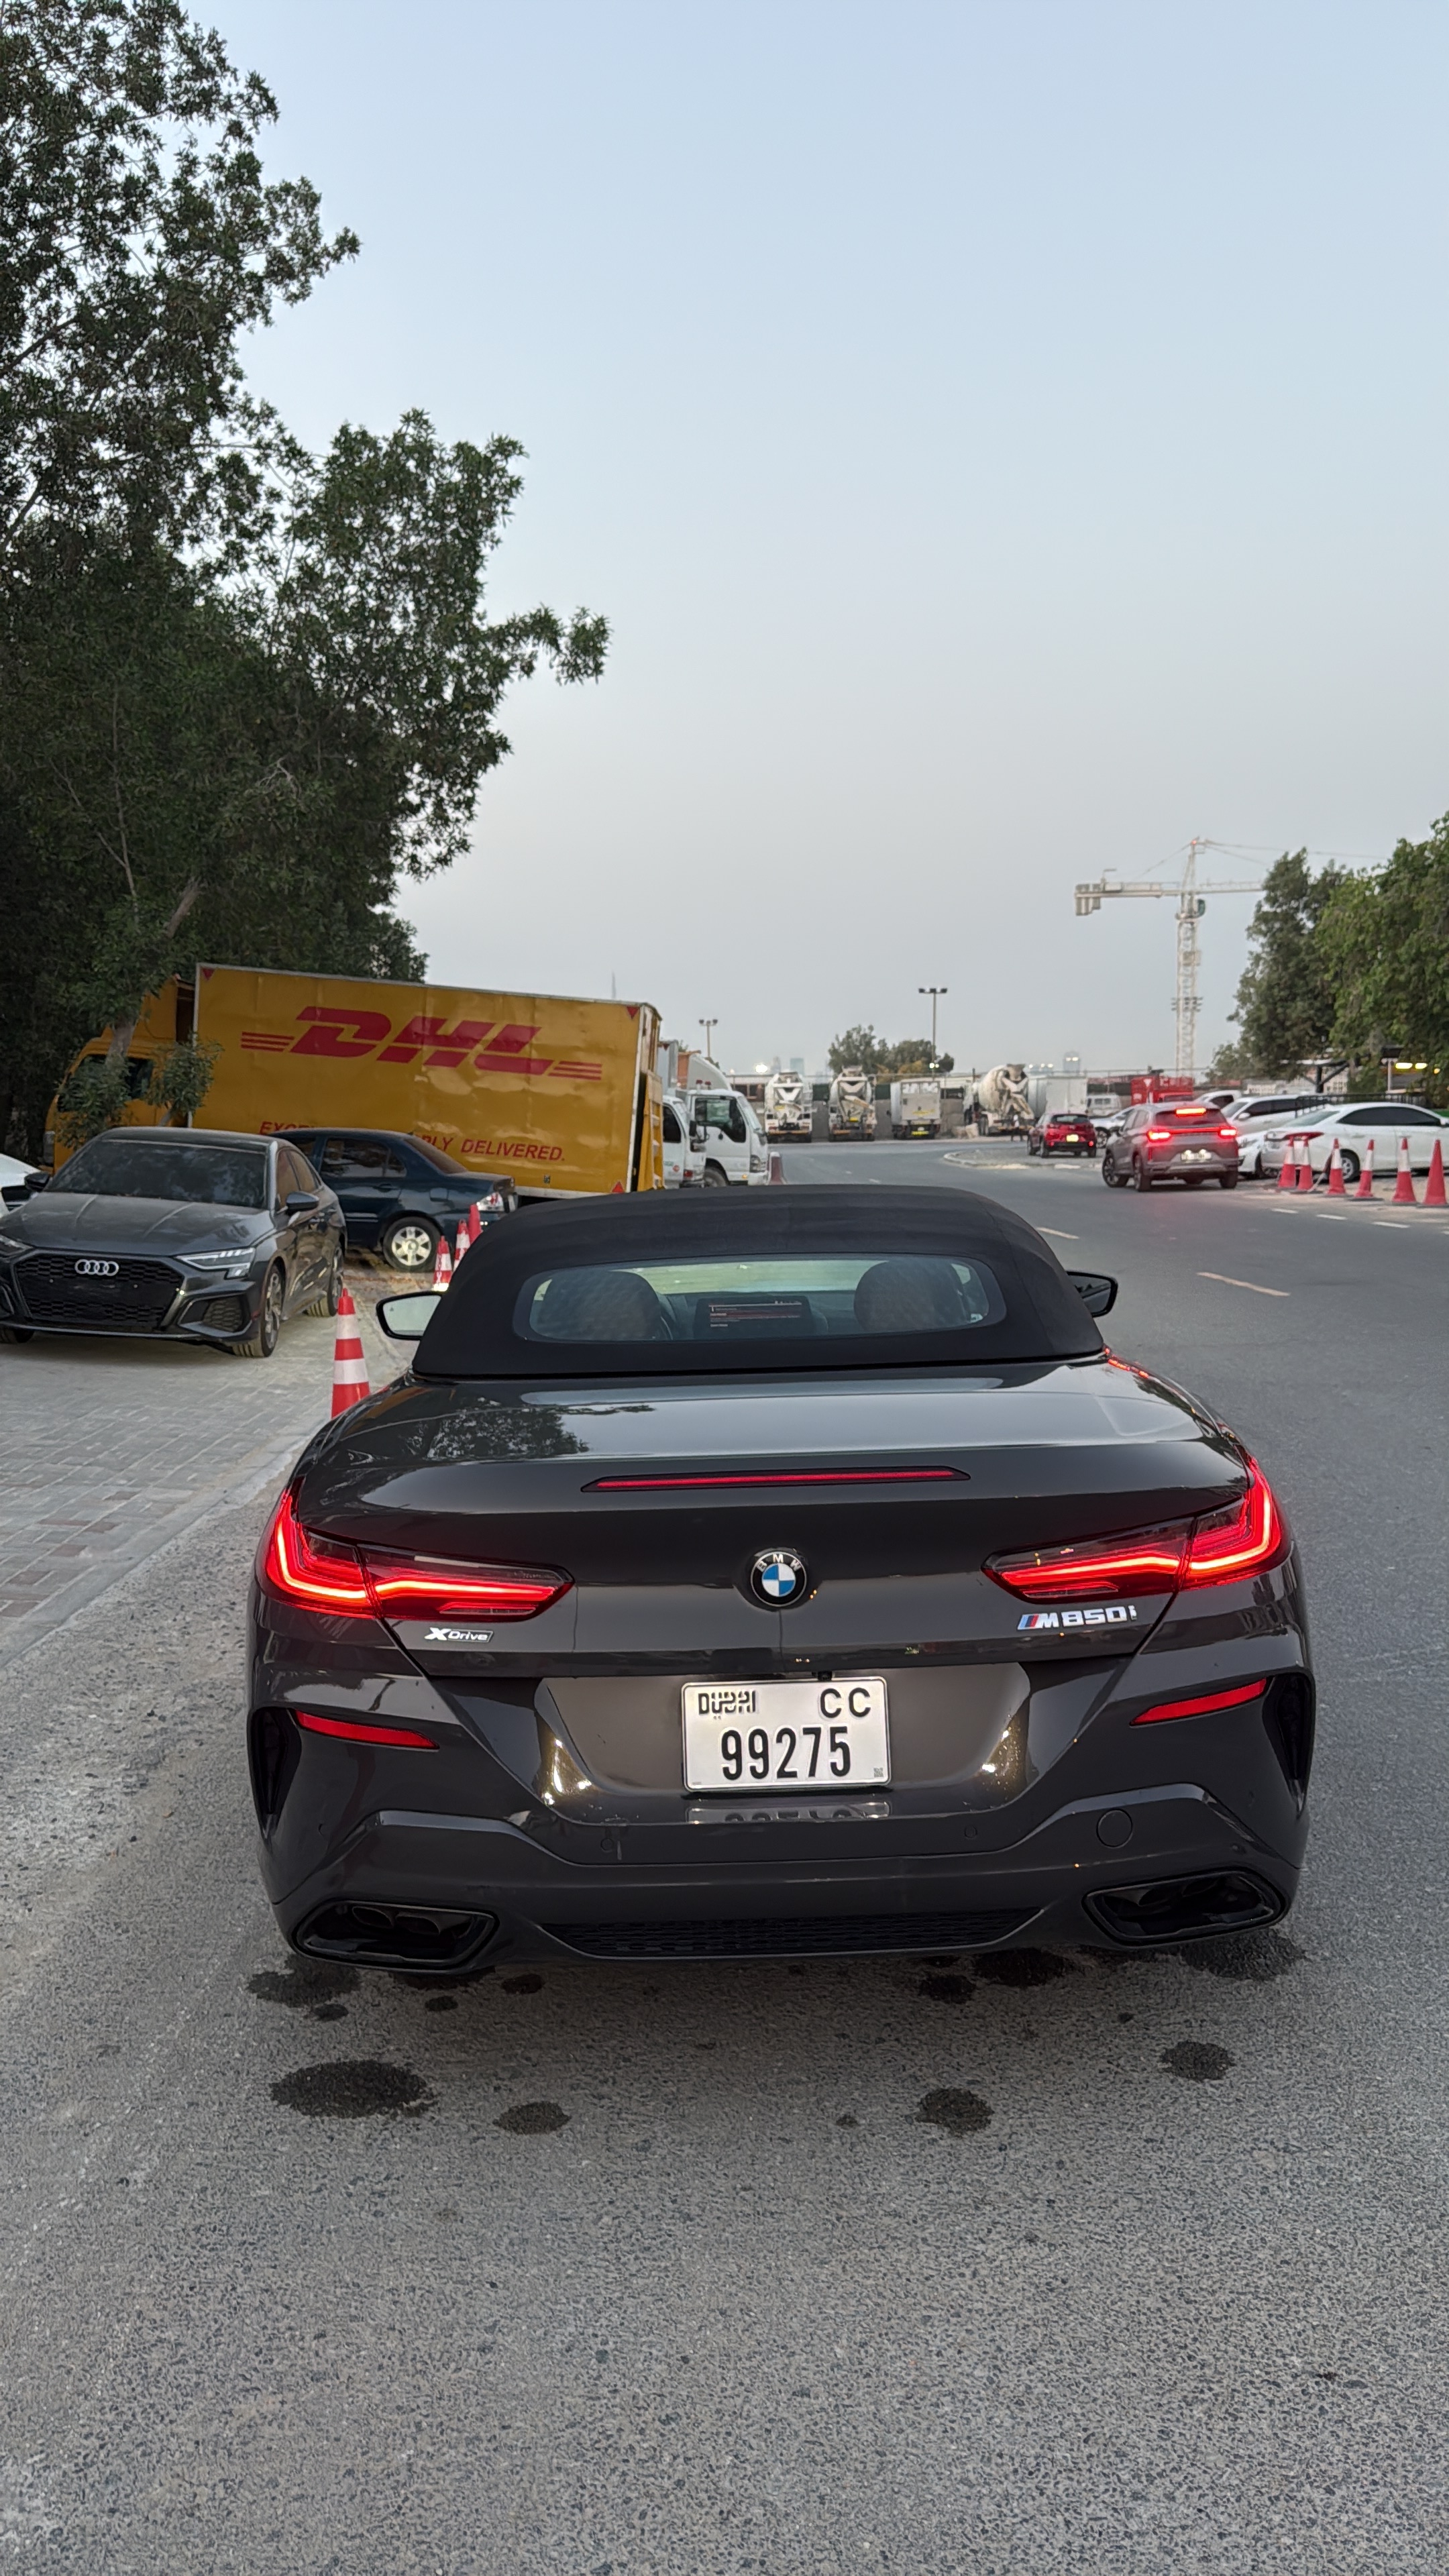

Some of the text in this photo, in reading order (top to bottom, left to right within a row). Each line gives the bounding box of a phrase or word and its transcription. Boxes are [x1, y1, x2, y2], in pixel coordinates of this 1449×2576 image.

[289, 1006, 553, 1075] DHL
[461, 1138, 565, 1161] DELIVERED.
[756, 1554, 802, 1572] BMW
[820, 1688, 871, 1718] CC
[721, 1726, 851, 1780] 99275
